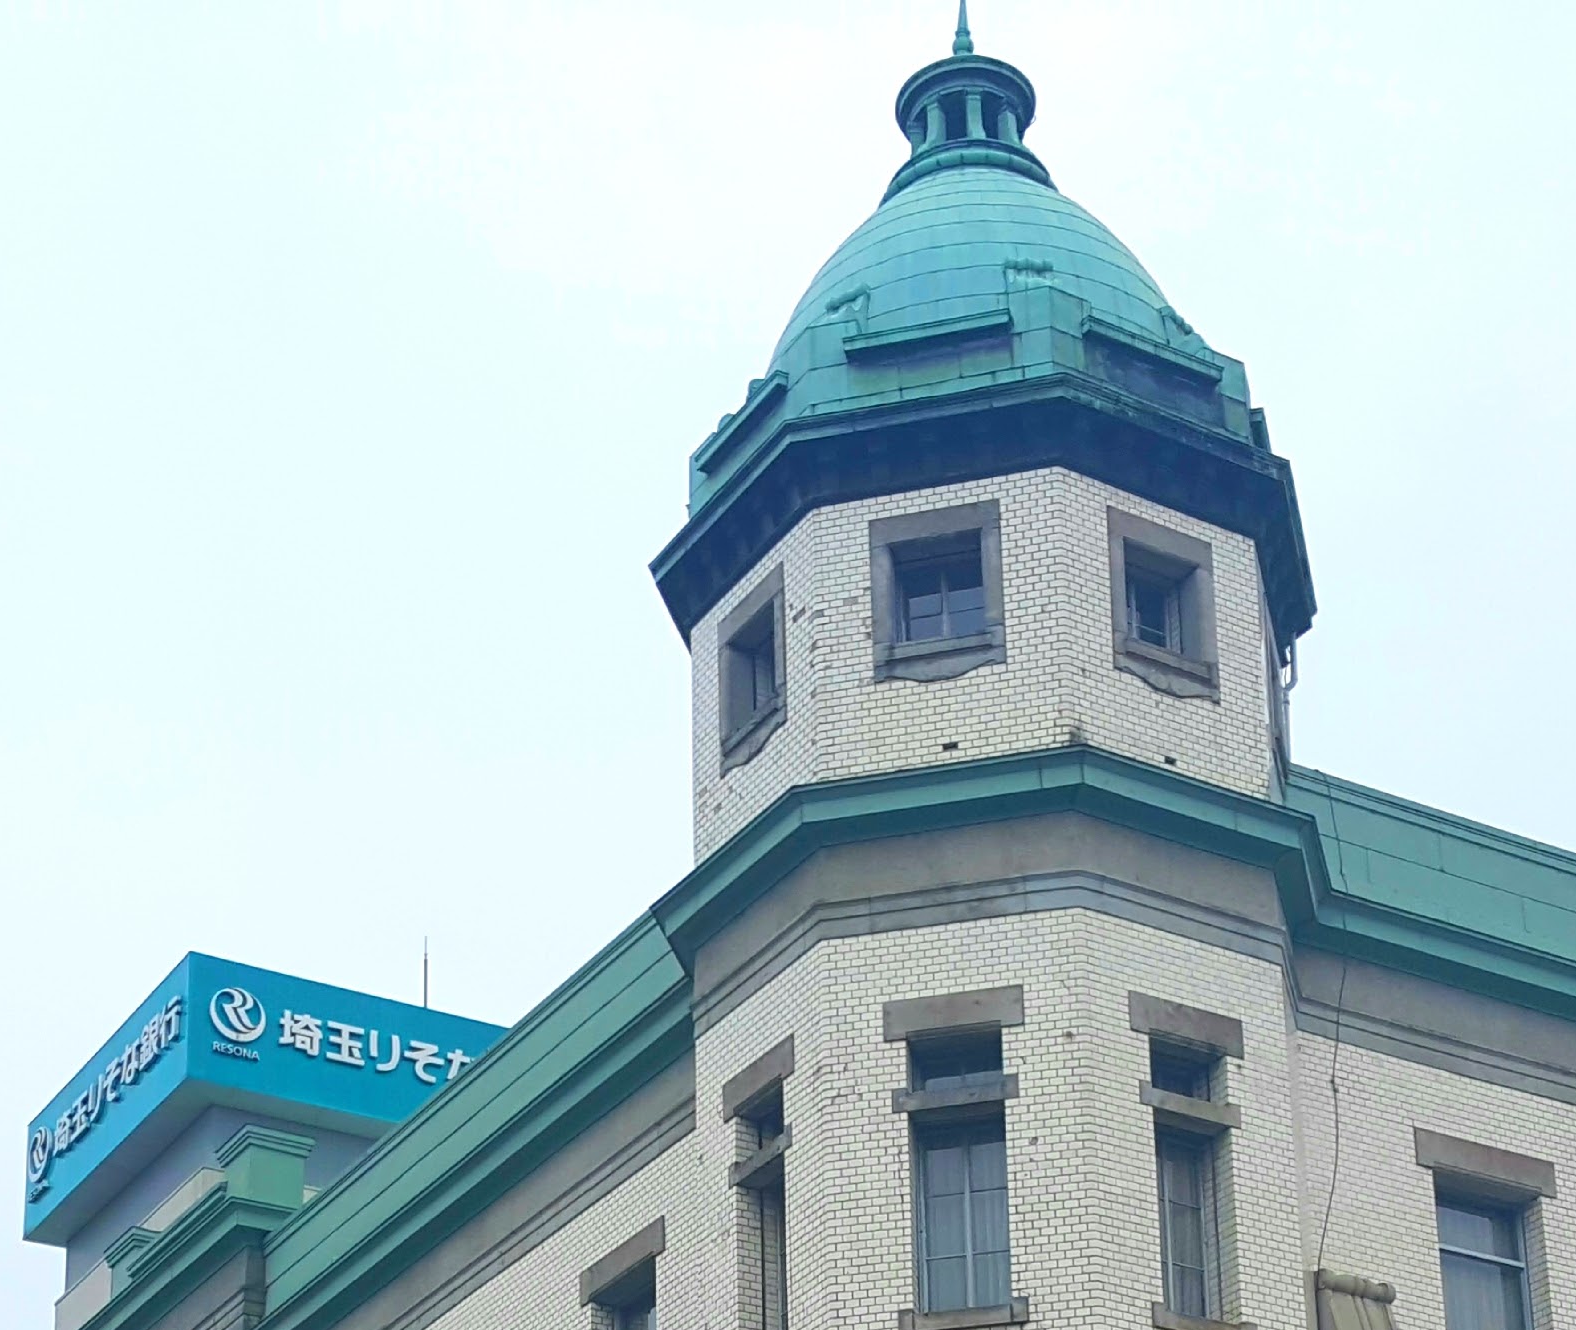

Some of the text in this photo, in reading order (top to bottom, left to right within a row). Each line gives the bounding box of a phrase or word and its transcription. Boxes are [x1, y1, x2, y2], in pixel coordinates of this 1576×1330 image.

[54, 995, 182, 1157] 埼玉りそな銀行
[212, 1040, 260, 1062] RESONA
